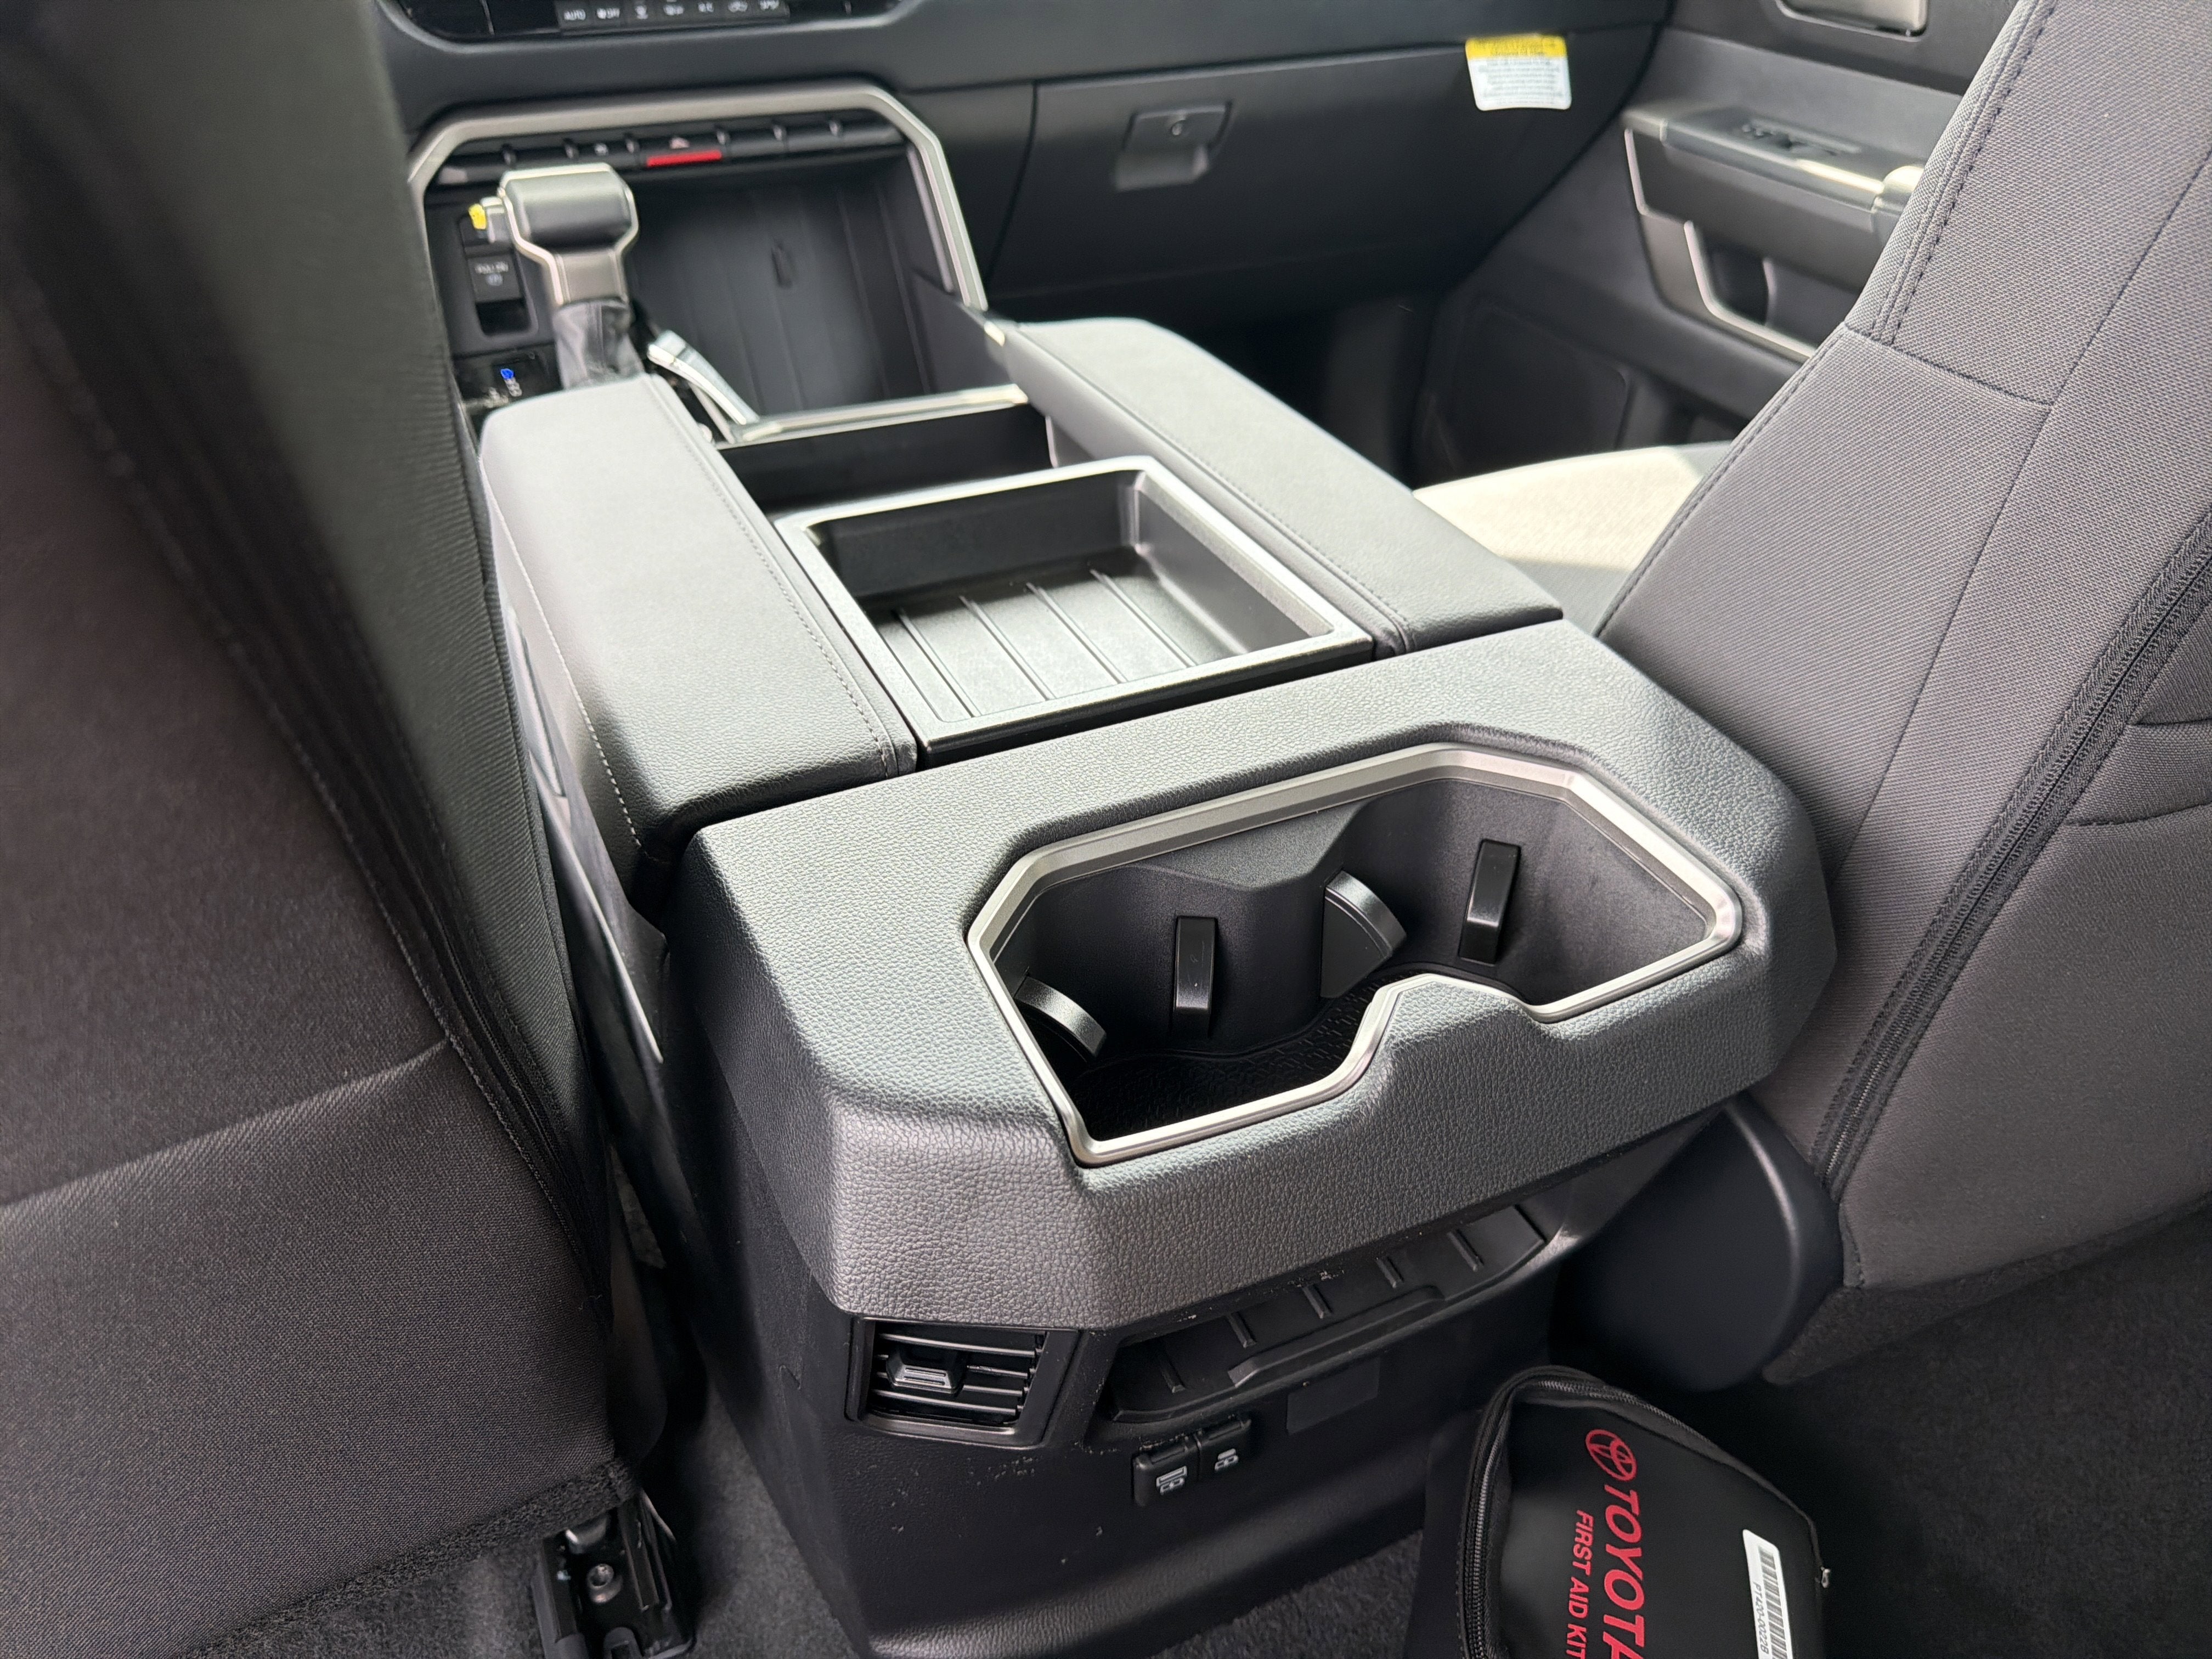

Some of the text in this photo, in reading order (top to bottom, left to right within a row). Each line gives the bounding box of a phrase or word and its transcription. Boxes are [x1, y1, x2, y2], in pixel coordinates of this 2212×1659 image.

[1566, 1510, 1594, 1659] FIRST AID KIT
[1603, 1485, 1645, 1659] TOYOTA
